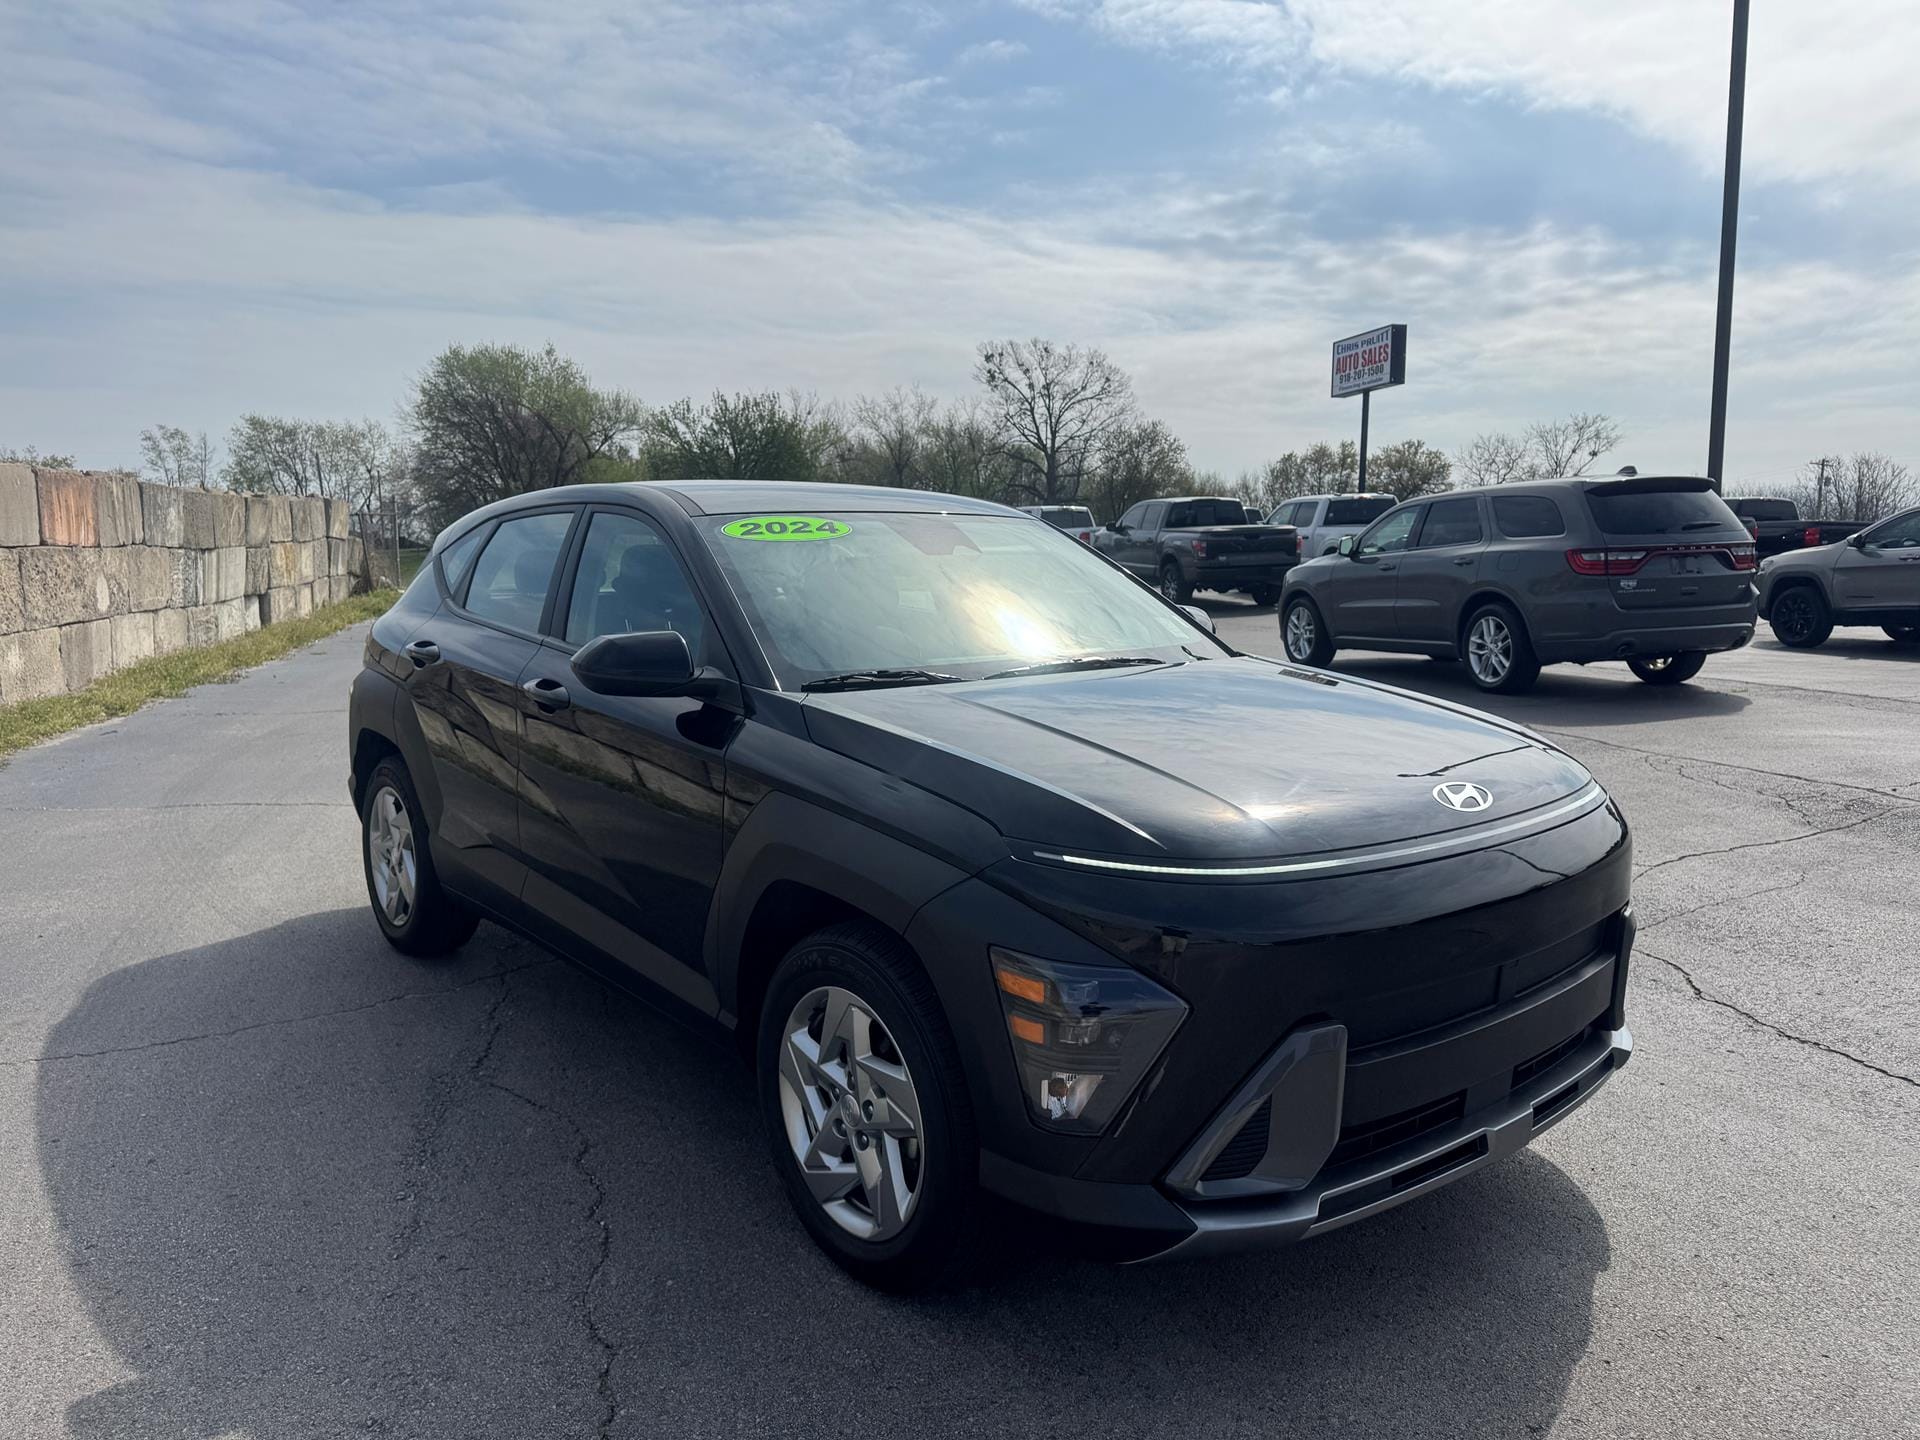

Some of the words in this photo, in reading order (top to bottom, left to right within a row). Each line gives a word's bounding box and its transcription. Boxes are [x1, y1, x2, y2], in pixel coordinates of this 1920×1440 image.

[1336, 342, 1359, 355] CHRIS
[1360, 329, 1390, 348] PRUITT
[1336, 352, 1360, 375] AUTO
[1361, 343, 1389, 368] SALES
[739, 520, 838, 536] 2024
